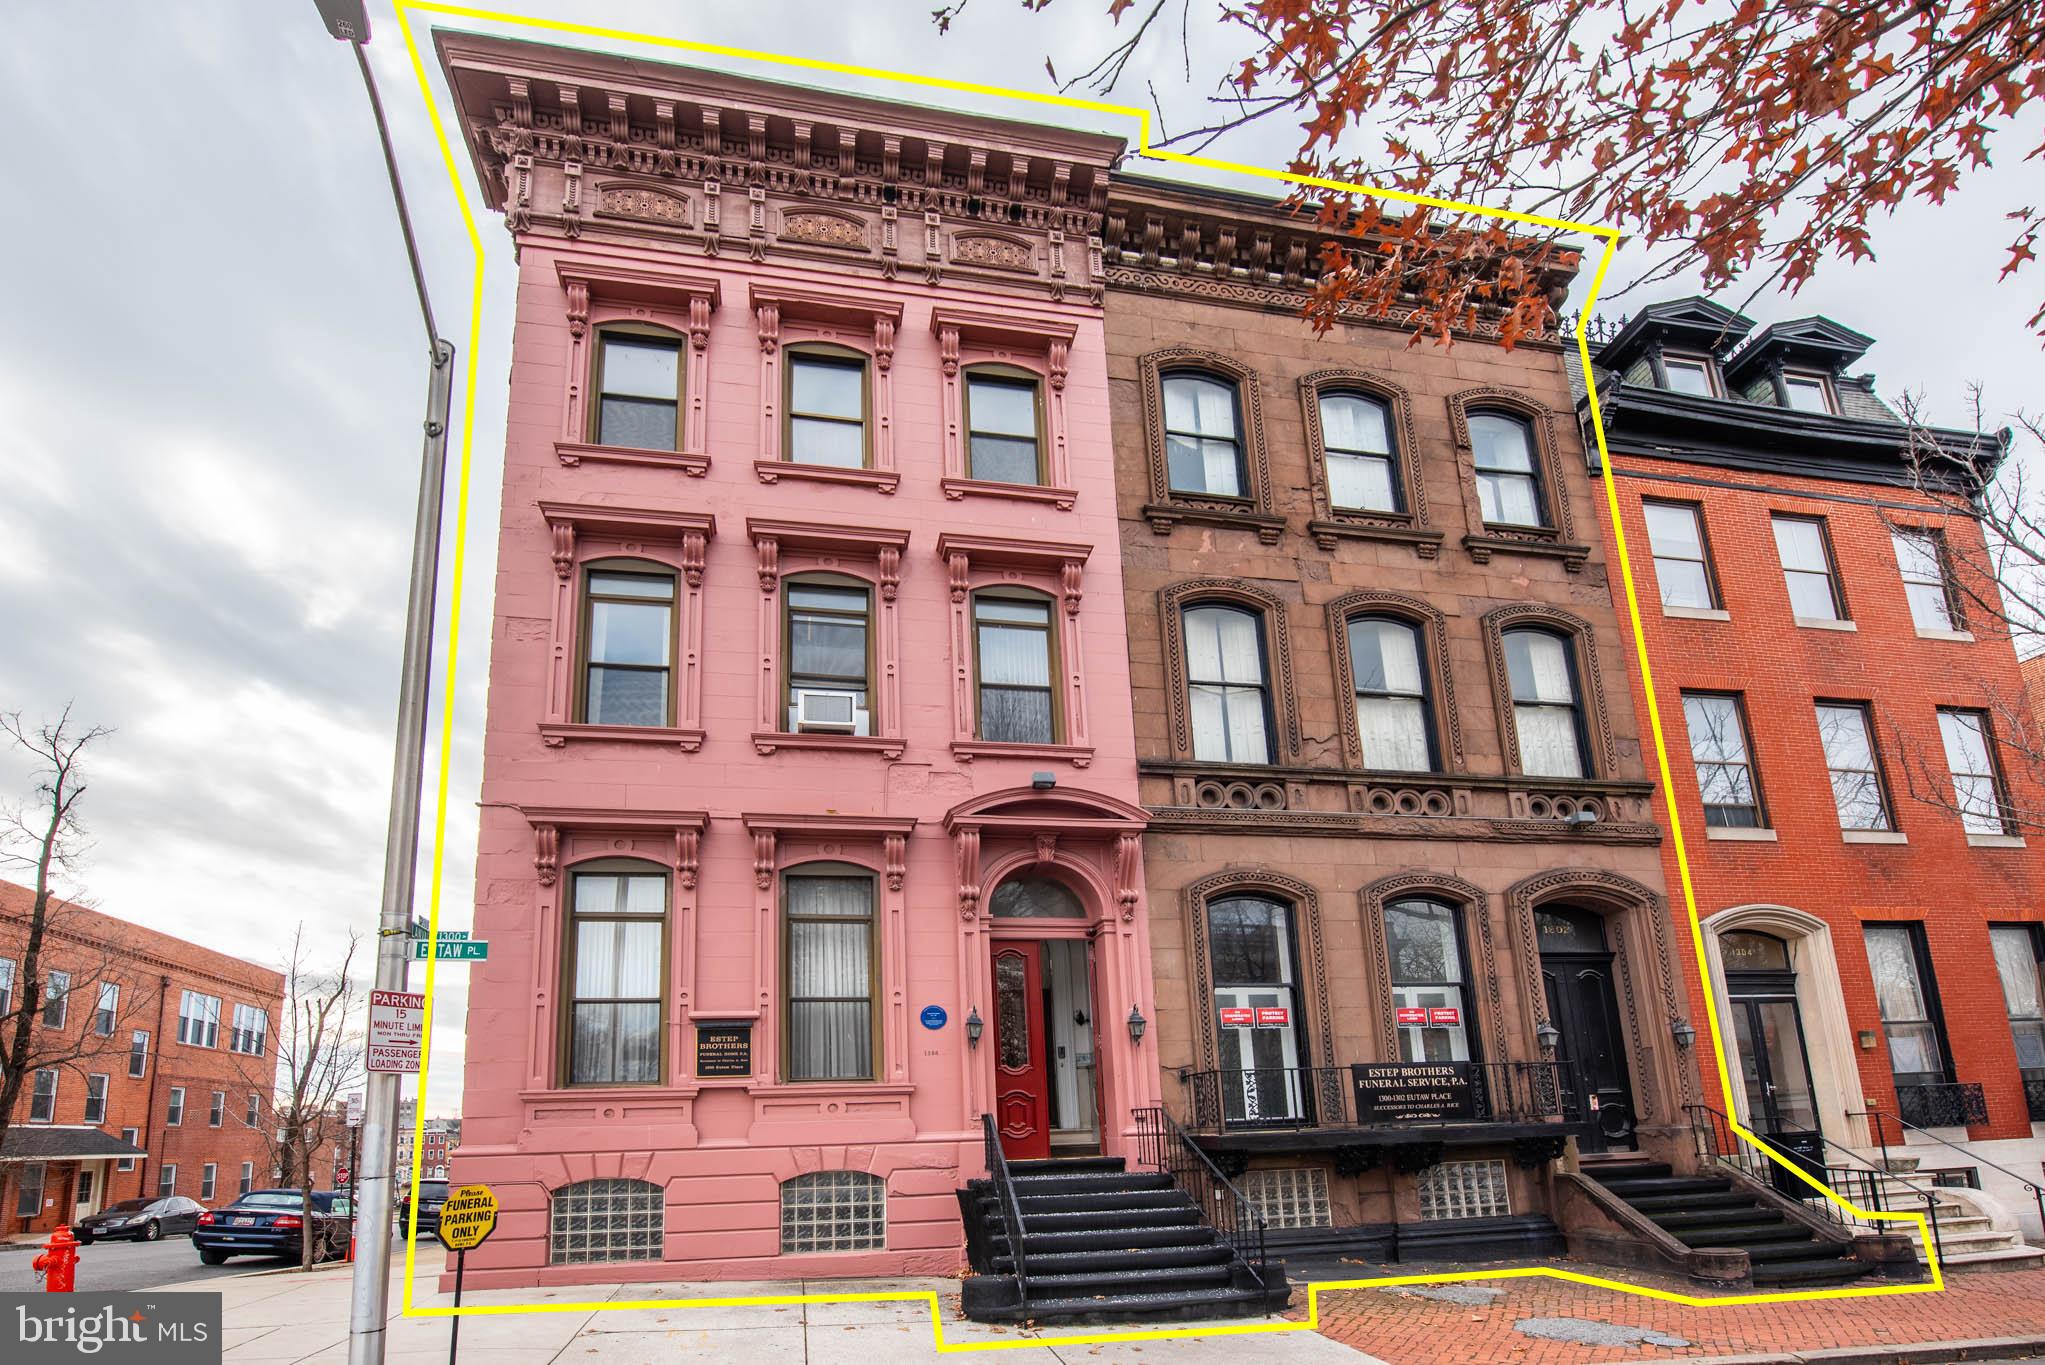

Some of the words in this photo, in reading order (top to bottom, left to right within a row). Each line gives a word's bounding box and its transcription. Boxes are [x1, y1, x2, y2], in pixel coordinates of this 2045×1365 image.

[439, 932, 461, 940] 1300
[421, 943, 463, 958] ETAW
[396, 1008, 407, 1019] 15
[373, 1020, 404, 1030] MINUTE
[700, 1042, 749, 1050] BROTHERS
[371, 1059, 402, 1069] LOADING
[405, 1060, 420, 1070] ZON
[1368, 1068, 1399, 1078] ESTEP
[1401, 1066, 1455, 1077] BROTHERS
[1359, 1078, 1406, 1089] FUNERAL
[1407, 1077, 1450, 1087] SERVICE,
[1451, 1077, 1468, 1086] P.A.
[1378, 1094, 1406, 1102] 1300-1302
[1406, 1093, 1430, 1101] EUTAW
[1431, 1092, 1452, 1100] PLACE
[446, 1197, 493, 1212] FUNERAL
[444, 1210, 491, 1226] PARKING
[452, 1226, 479, 1239] ONLY
